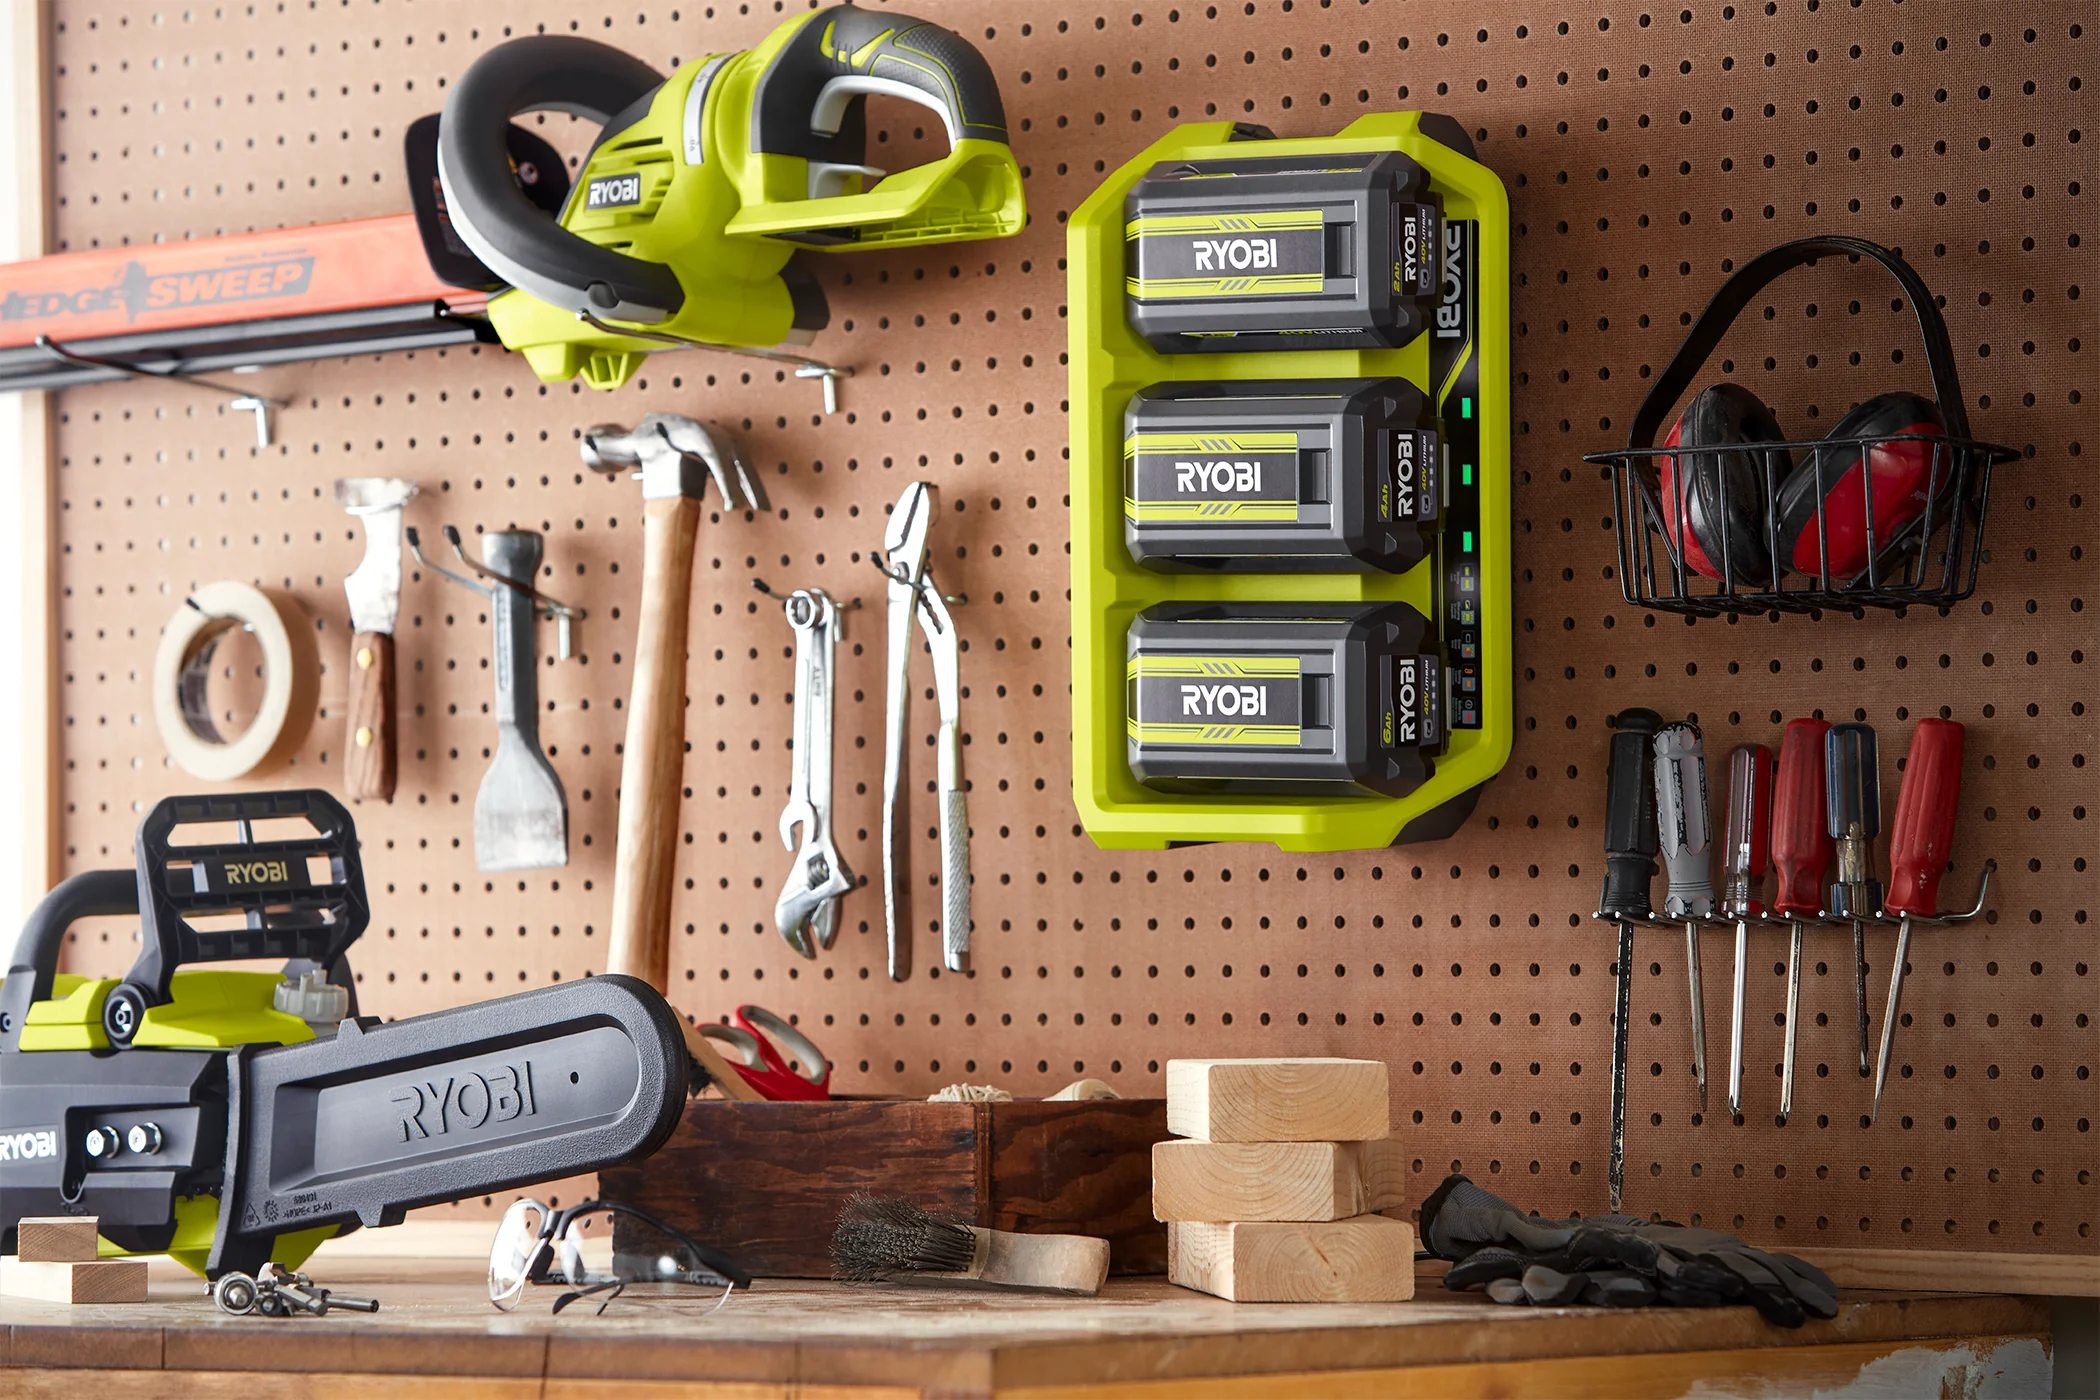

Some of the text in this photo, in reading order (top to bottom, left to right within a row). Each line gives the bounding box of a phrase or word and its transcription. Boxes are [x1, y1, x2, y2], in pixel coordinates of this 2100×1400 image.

[589, 178, 639, 205] RYOBI
[1192, 239, 1277, 271] RYOBI
[1405, 217, 1416, 282] RYOBI
[145, 262, 304, 308] SWEEP
[1175, 462, 1261, 492] RYOBI
[1397, 434, 1413, 517] RYOBI
[1380, 483, 1388, 518] 4Ah
[1181, 684, 1266, 717] RYOBI
[1400, 659, 1415, 743] RYOBI
[1382, 711, 1392, 744] 6Ah
[225, 861, 288, 884] RYOBI
[391, 1061, 538, 1142] RYOBI
[0, 1131, 57, 1161] RYOBI
